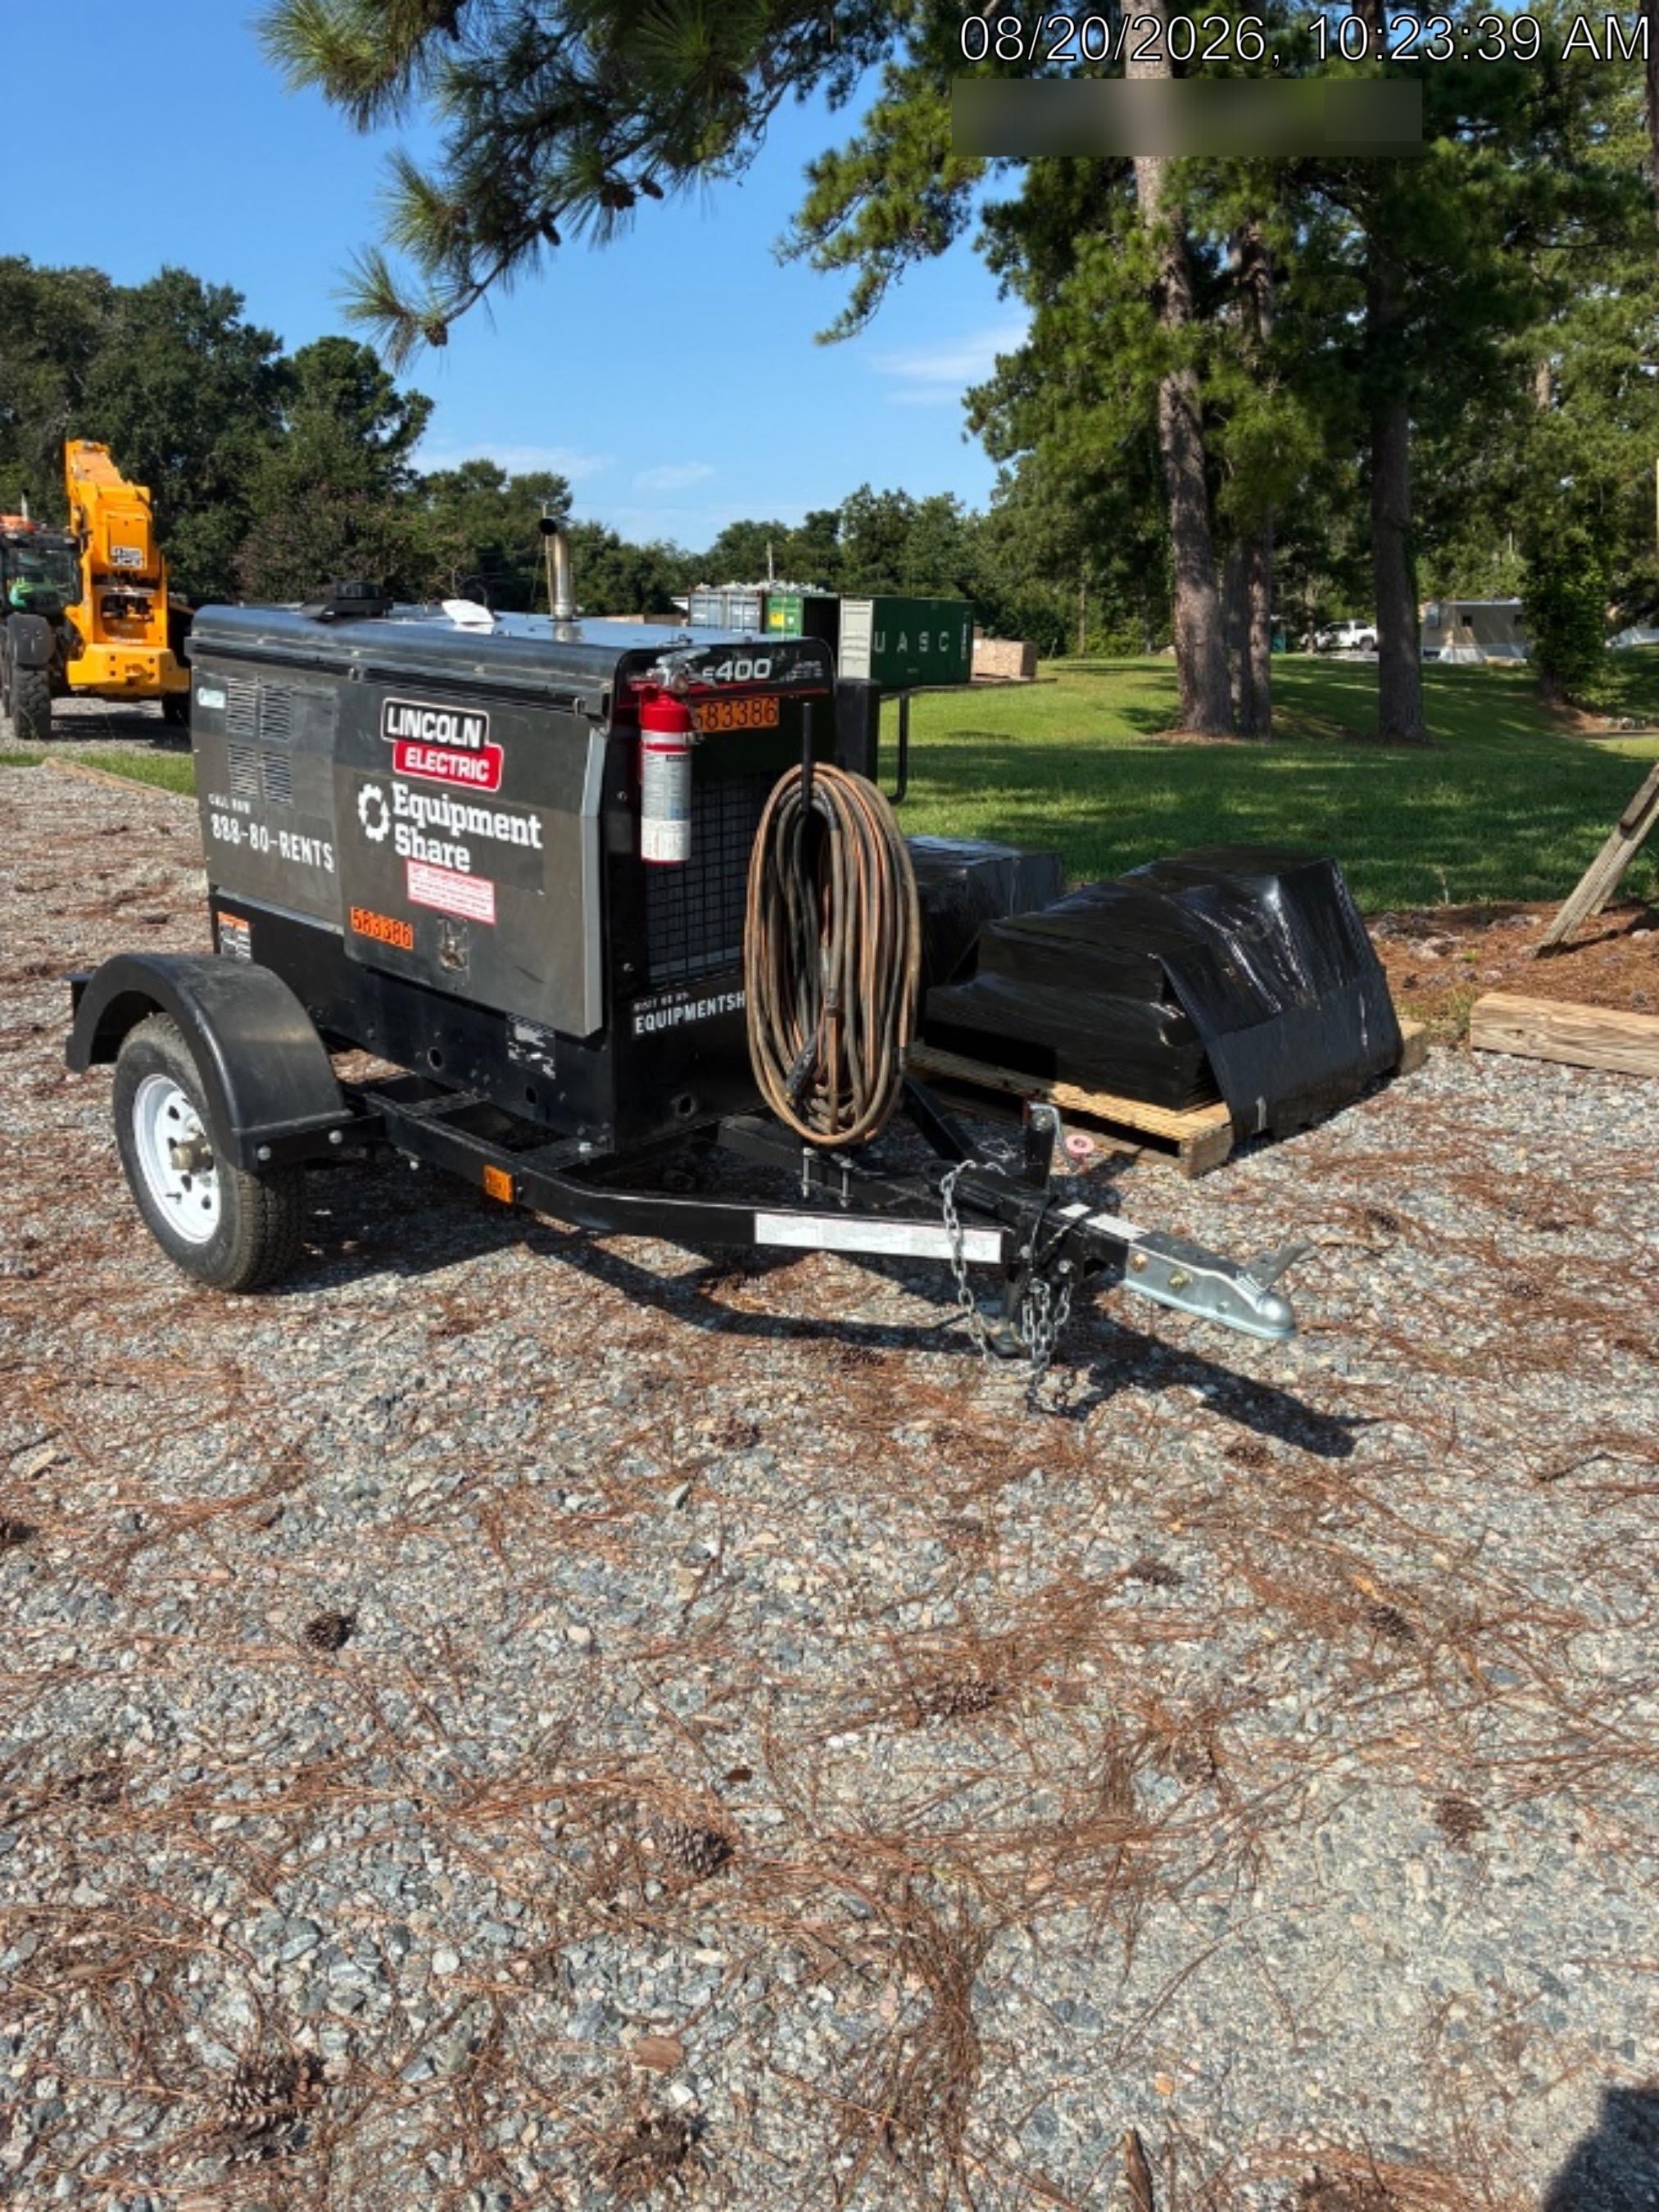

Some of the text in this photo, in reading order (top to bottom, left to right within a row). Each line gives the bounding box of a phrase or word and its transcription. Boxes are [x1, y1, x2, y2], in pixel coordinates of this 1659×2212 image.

[715, 658, 772, 682] 400
[387, 706, 483, 749] LINCOLN
[405, 746, 490, 782] ELECTRIC
[392, 782, 543, 849] Equipment
[211, 813, 334, 873] 888-80-RENTS
[394, 823, 470, 873] Share
